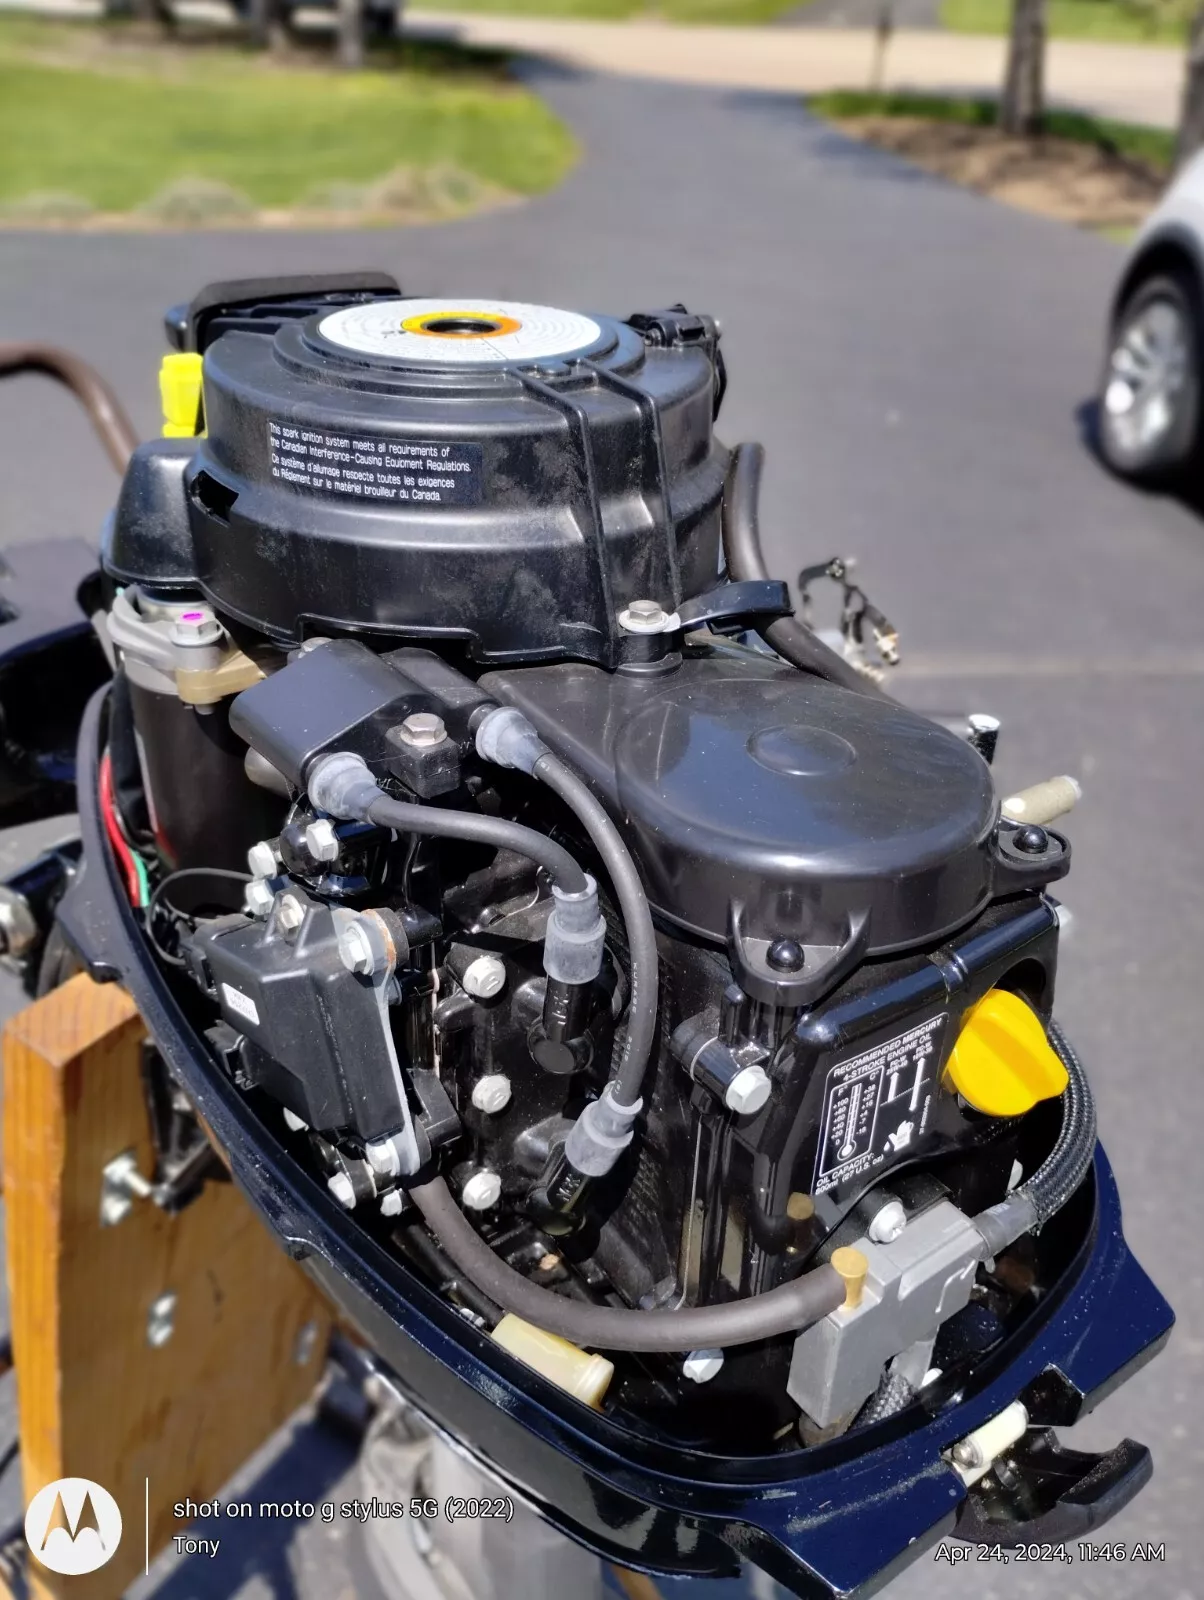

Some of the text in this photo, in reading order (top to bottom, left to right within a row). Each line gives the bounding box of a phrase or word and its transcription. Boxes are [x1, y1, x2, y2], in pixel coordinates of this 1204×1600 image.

[269, 422, 451, 458] This spark ignition system meets all requirements of
[270, 435, 471, 472] the Canadian Interference-Causing Equipment Regulations.
[271, 453, 455, 488] Ce système d'allumage respecte toutes les exigences
[272, 466, 280, 477] du
[312, 477, 323, 487] sur
[325, 478, 332, 489] le
[334, 480, 362, 494] matériel
[364, 484, 397, 497] brouilleur
[400, 488, 409, 499] du
[411, 489, 441, 501] Canada.
[833, 1017, 943, 1077] RECOMMENDED MERCURY
[843, 1032, 932, 1081] 4-STROKE ENGINE OIL
[832, 1098, 849, 1109] +100
[862, 1092, 875, 1102] +27
[832, 1121, 845, 1132] +40
[815, 1153, 884, 1195] 800ml (27 U.S. oz)
[816, 1153, 875, 1187] OIL CAPACITY:
